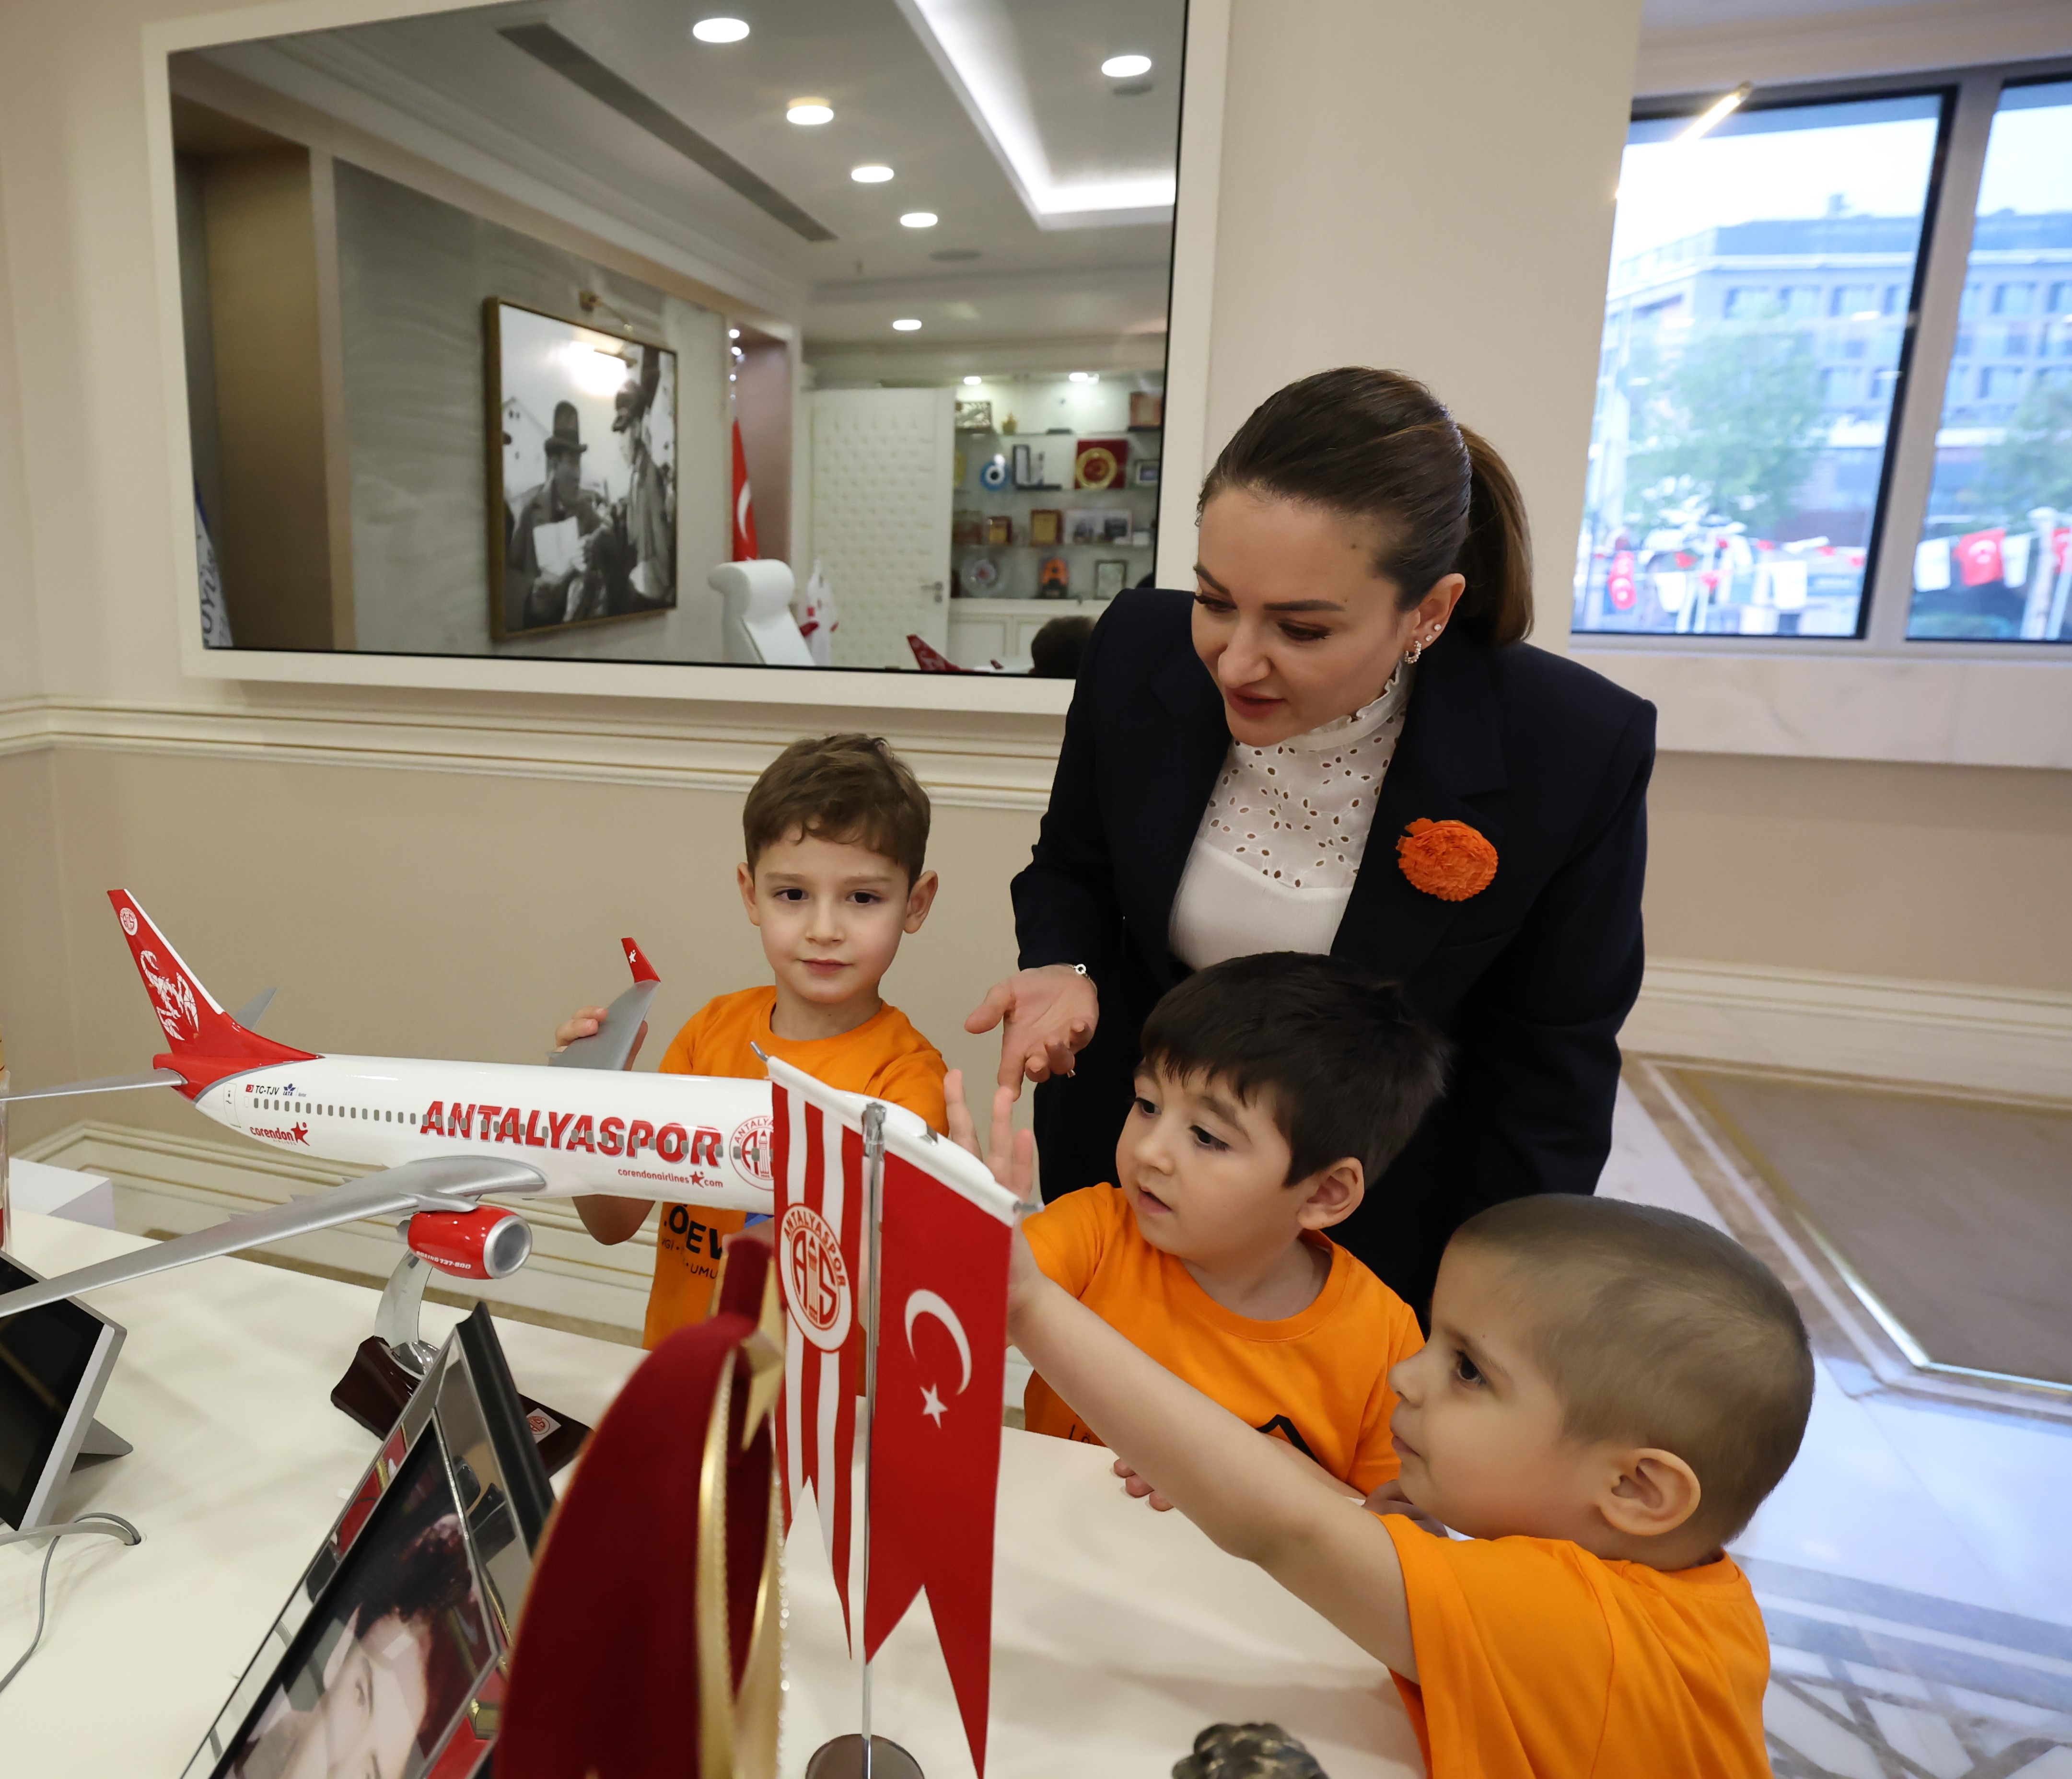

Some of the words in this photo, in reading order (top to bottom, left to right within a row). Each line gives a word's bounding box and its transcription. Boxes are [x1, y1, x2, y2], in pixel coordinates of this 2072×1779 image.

[256, 1085, 279, 1095] TC-TJV
[250, 1127, 294, 1141] corendon
[419, 1101, 722, 1169] ANTALYASPOR
[784, 1210, 846, 1287] ANTALYASPOR
[439, 1258, 472, 1270] 737-800
